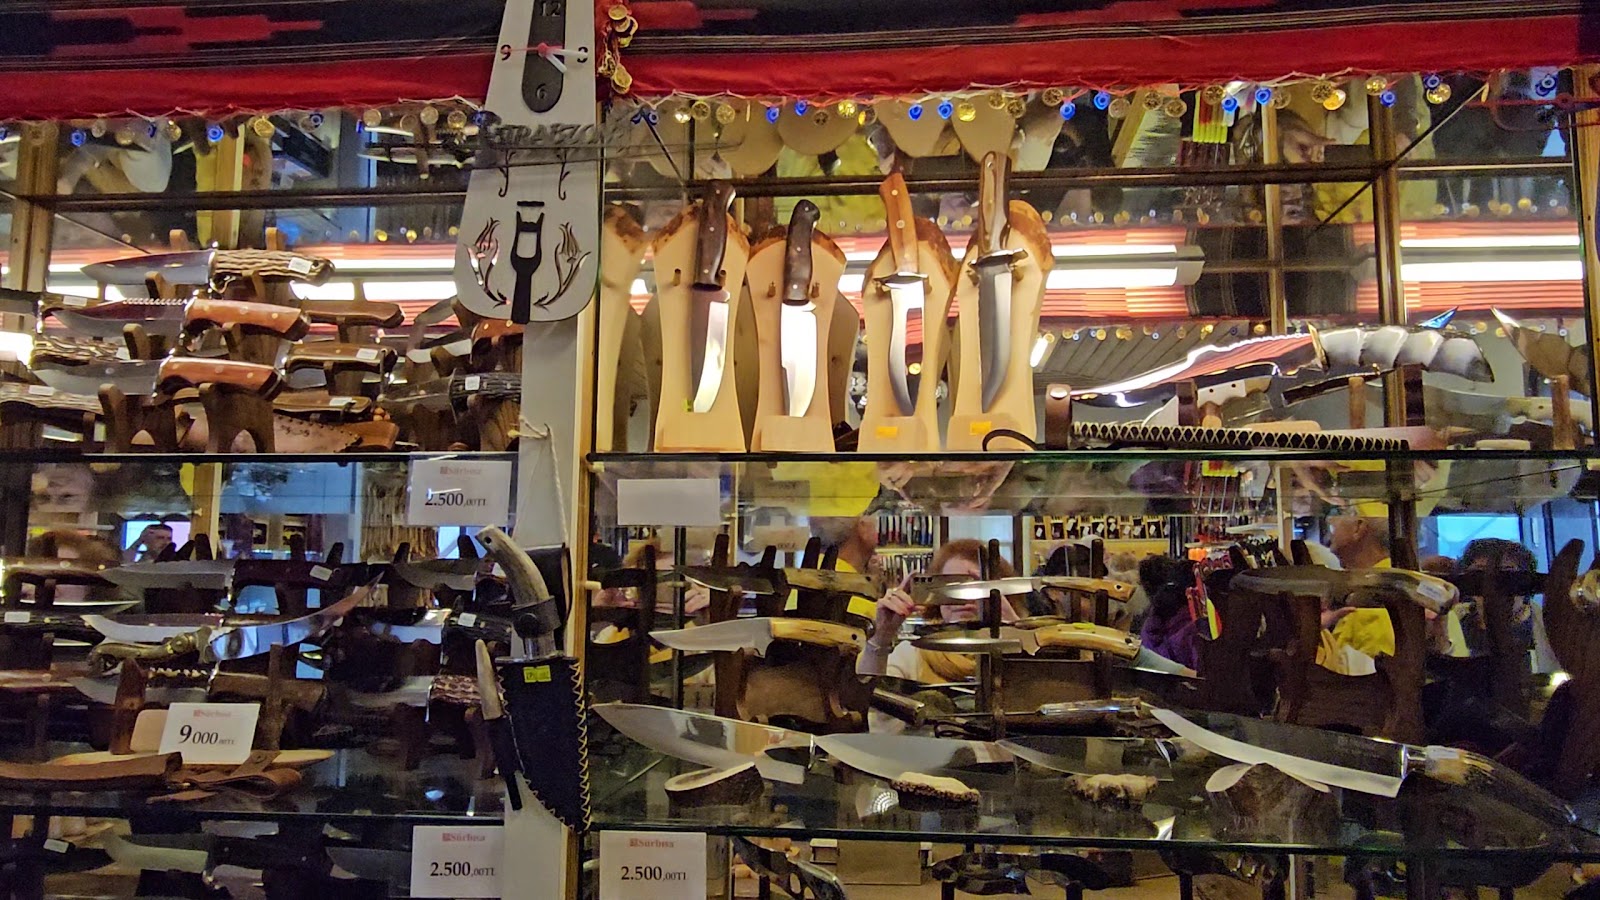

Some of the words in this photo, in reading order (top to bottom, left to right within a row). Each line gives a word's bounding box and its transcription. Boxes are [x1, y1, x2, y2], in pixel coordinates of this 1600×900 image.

[541, 1, 561, 17] 12
[500, 44, 512, 61] 9
[535, 82, 548, 100] 6
